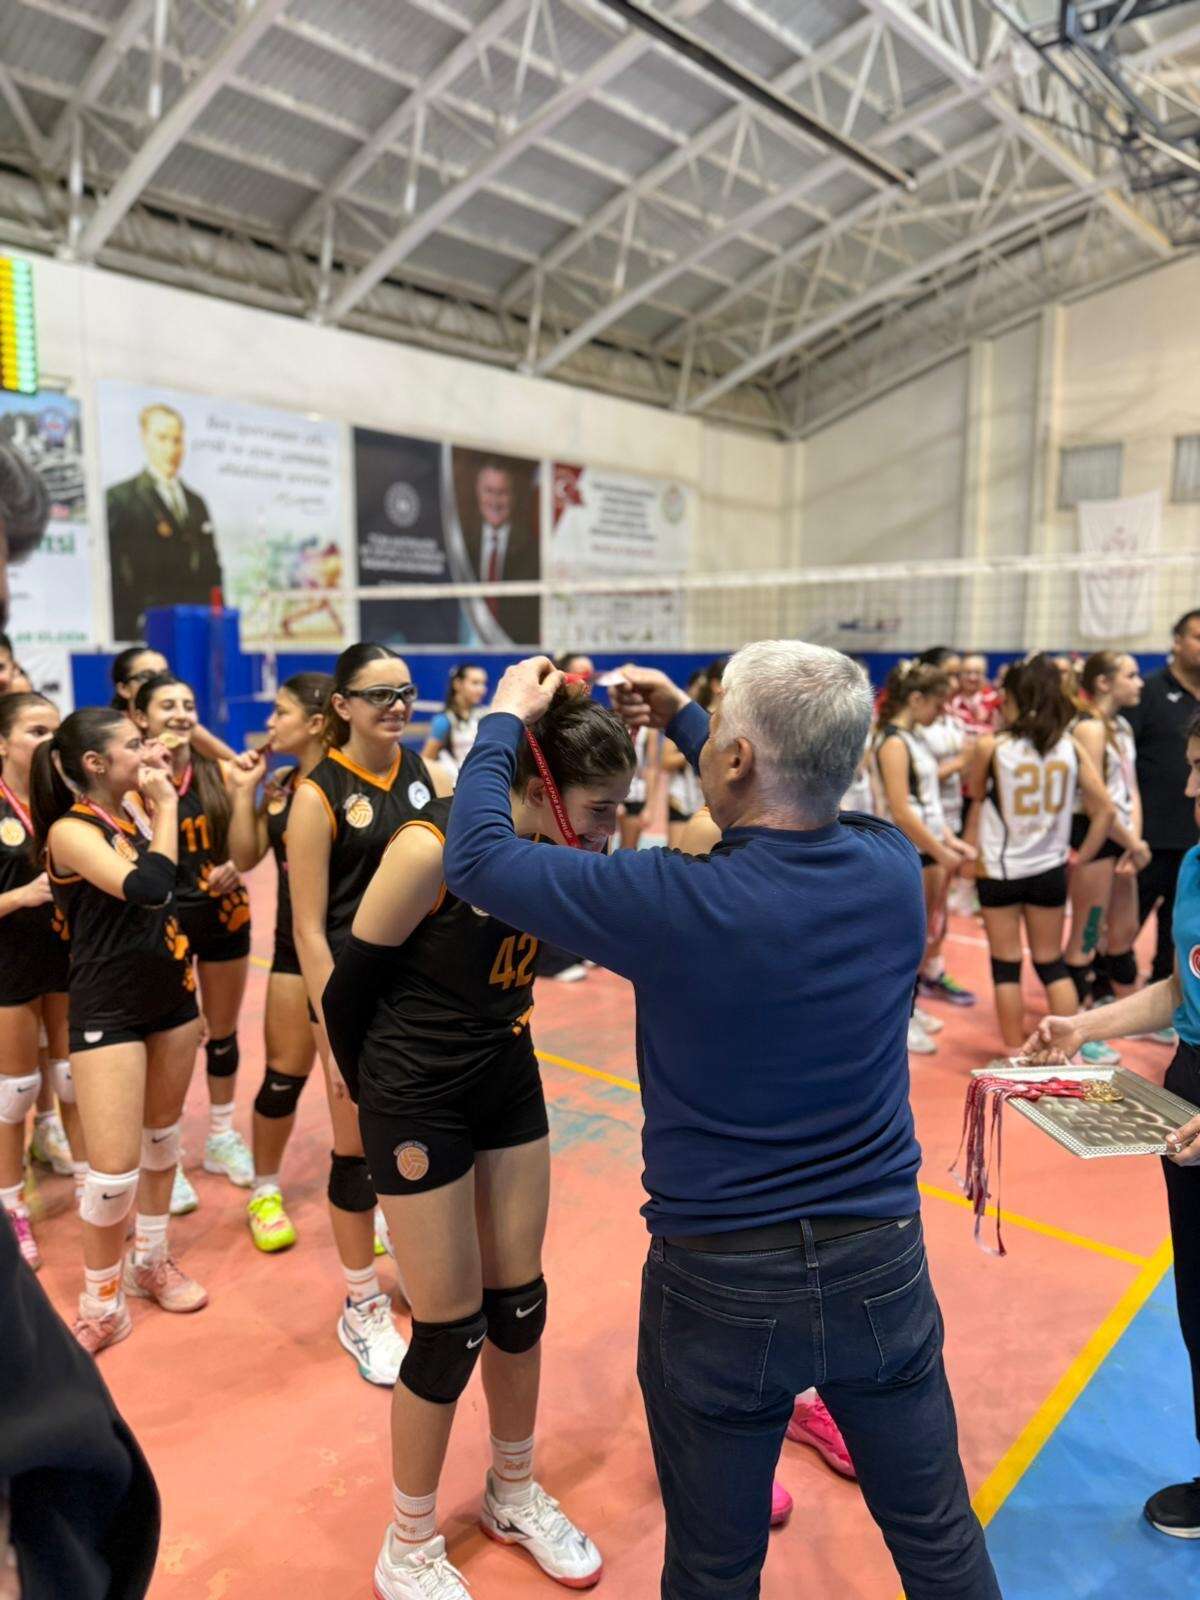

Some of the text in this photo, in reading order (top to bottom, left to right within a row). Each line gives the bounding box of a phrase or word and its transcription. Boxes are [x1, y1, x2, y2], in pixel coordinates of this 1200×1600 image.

[548, 786, 560, 804] SPOR
[1013, 761, 1069, 815] 20
[181, 815, 209, 852] 11
[488, 932, 538, 990] 42
